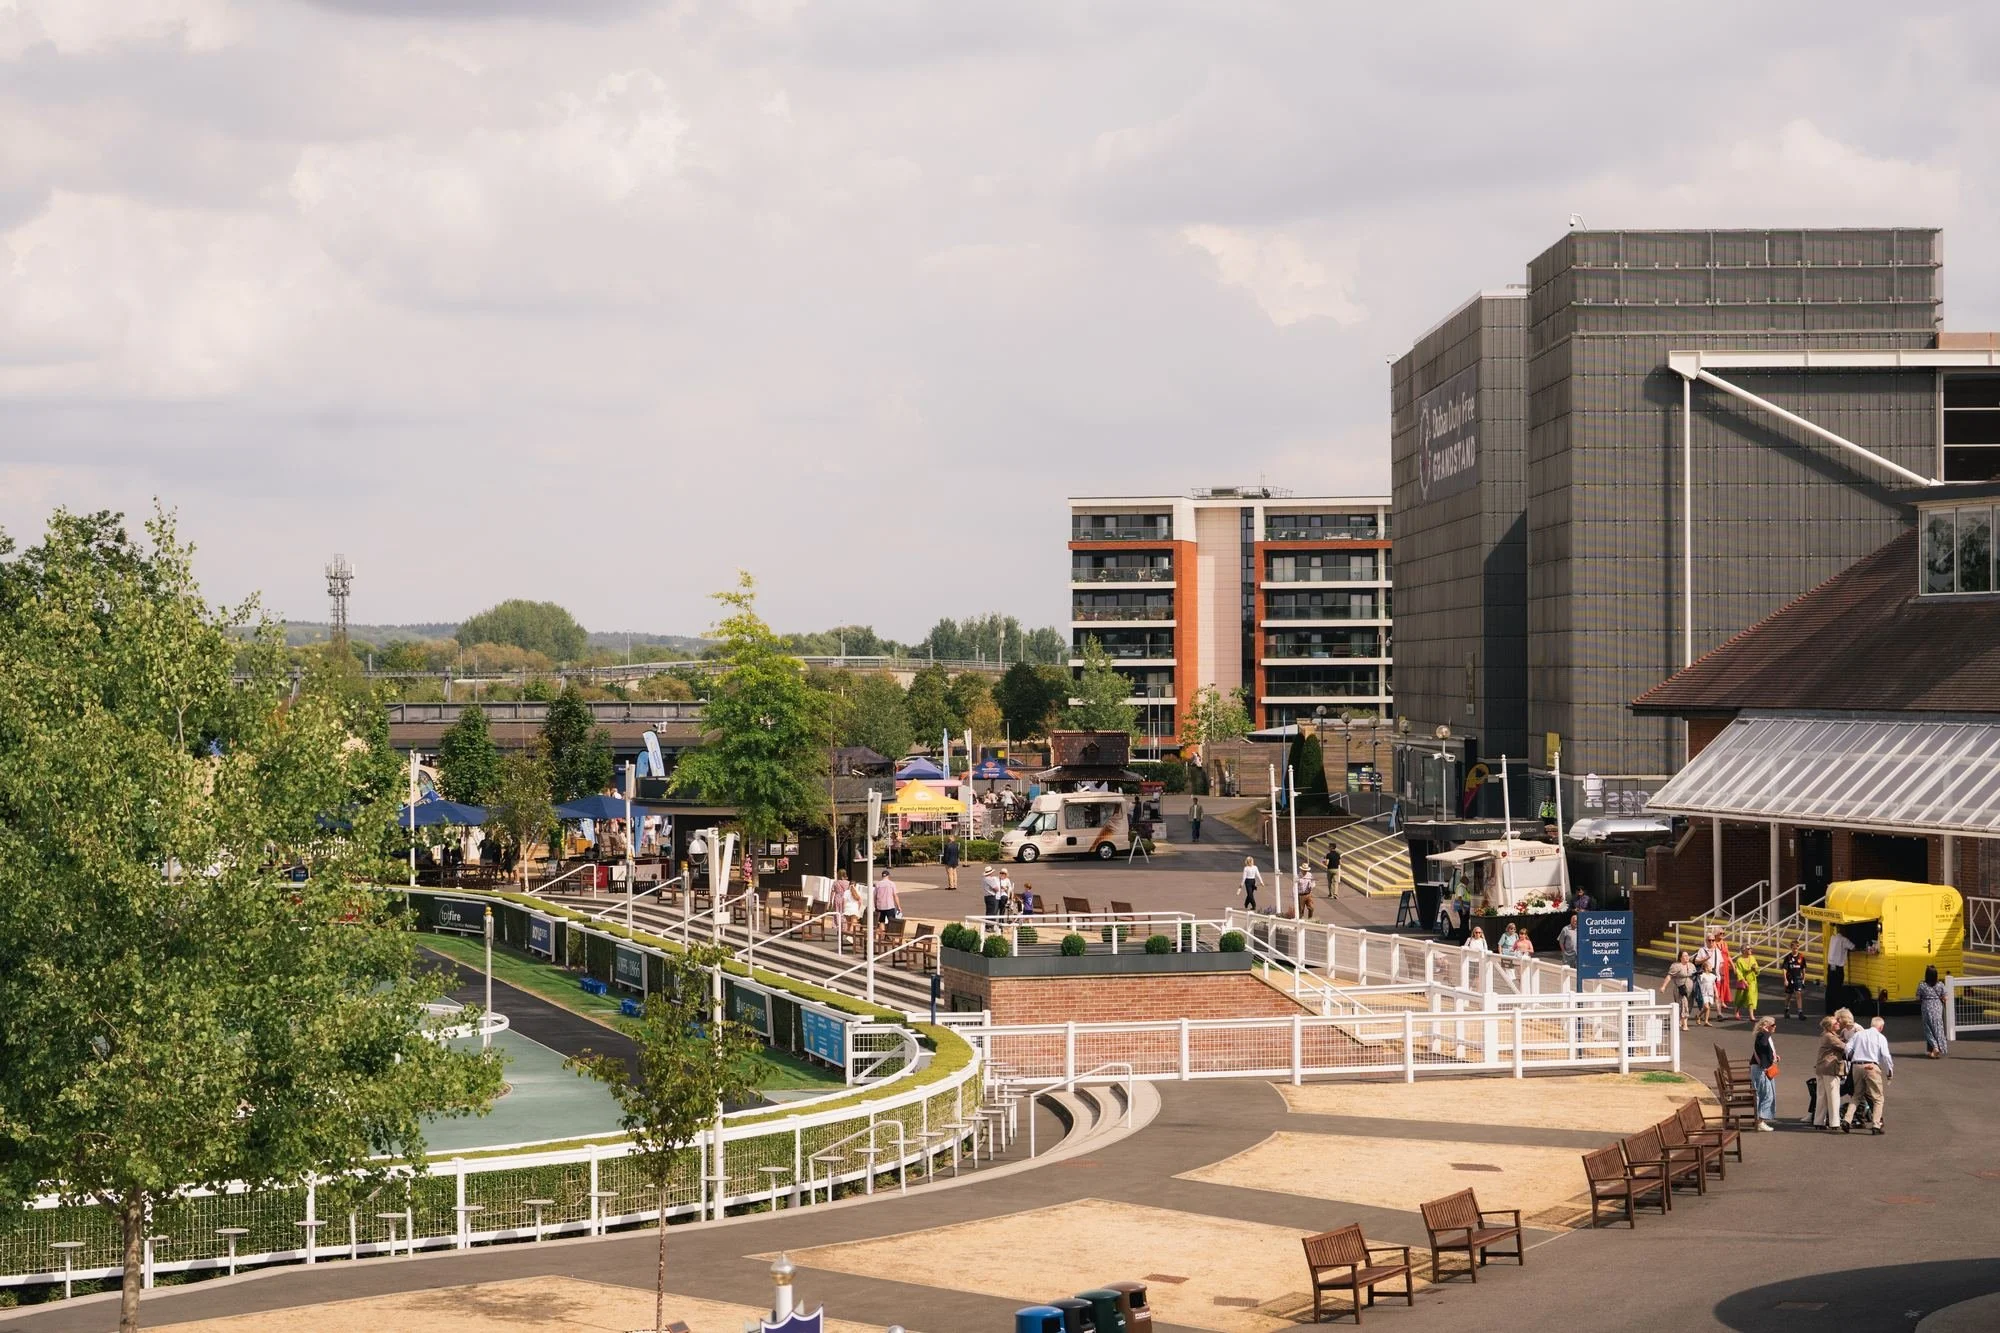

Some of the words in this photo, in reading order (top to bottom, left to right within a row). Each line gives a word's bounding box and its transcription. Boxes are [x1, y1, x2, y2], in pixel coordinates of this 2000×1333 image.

[1433, 405, 1448, 440] Dubai
[1448, 396, 1461, 437] Duty
[1461, 391, 1475, 425] Free
[1432, 435, 1476, 482] GRANDSTAND
[1585, 917, 1625, 926] Grandstand
[1589, 927, 1622, 935] Enclosure
[1592, 941, 1619, 949] Racegoers
